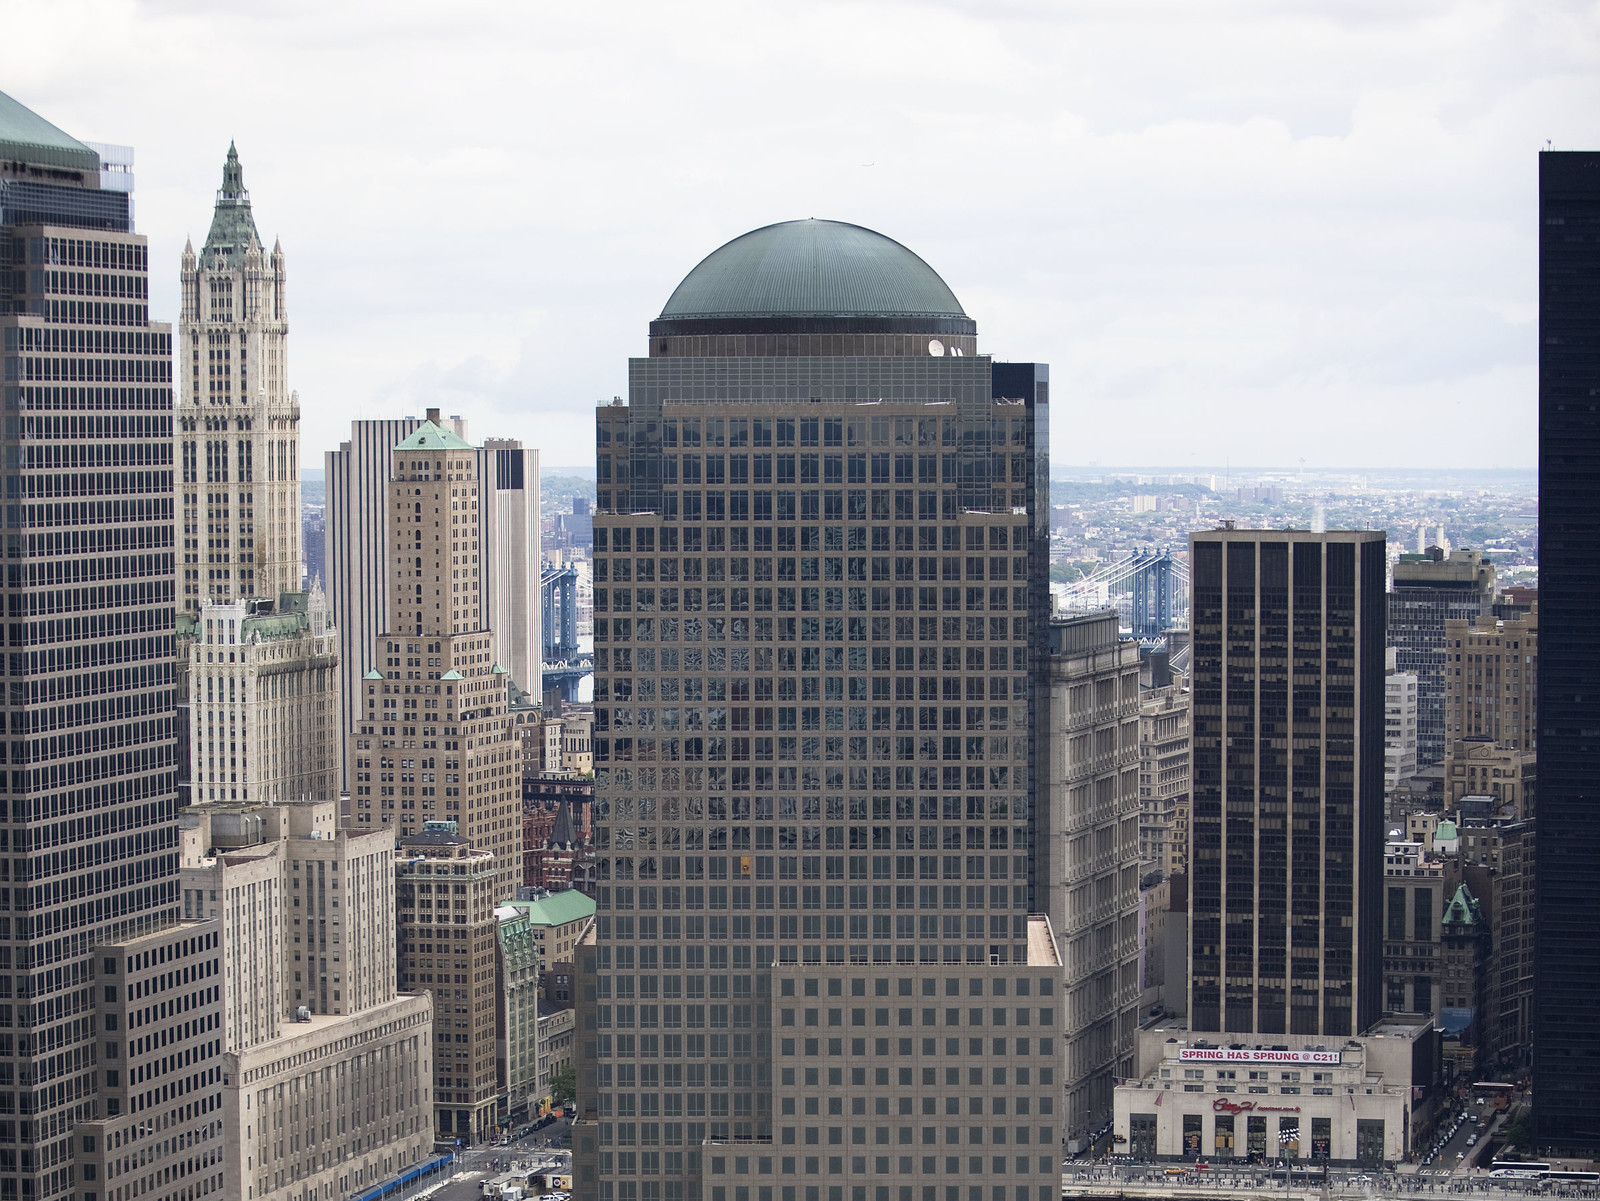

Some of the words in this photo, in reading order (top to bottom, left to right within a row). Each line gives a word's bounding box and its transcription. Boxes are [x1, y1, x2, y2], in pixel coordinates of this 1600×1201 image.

[1182, 1051, 1223, 1059] SPRING
[1227, 1051, 1250, 1059] HAS
[1253, 1052, 1299, 1060] SPRUNG
[1303, 1053, 1310, 1061] @
[1313, 1053, 1337, 1061] C21!
